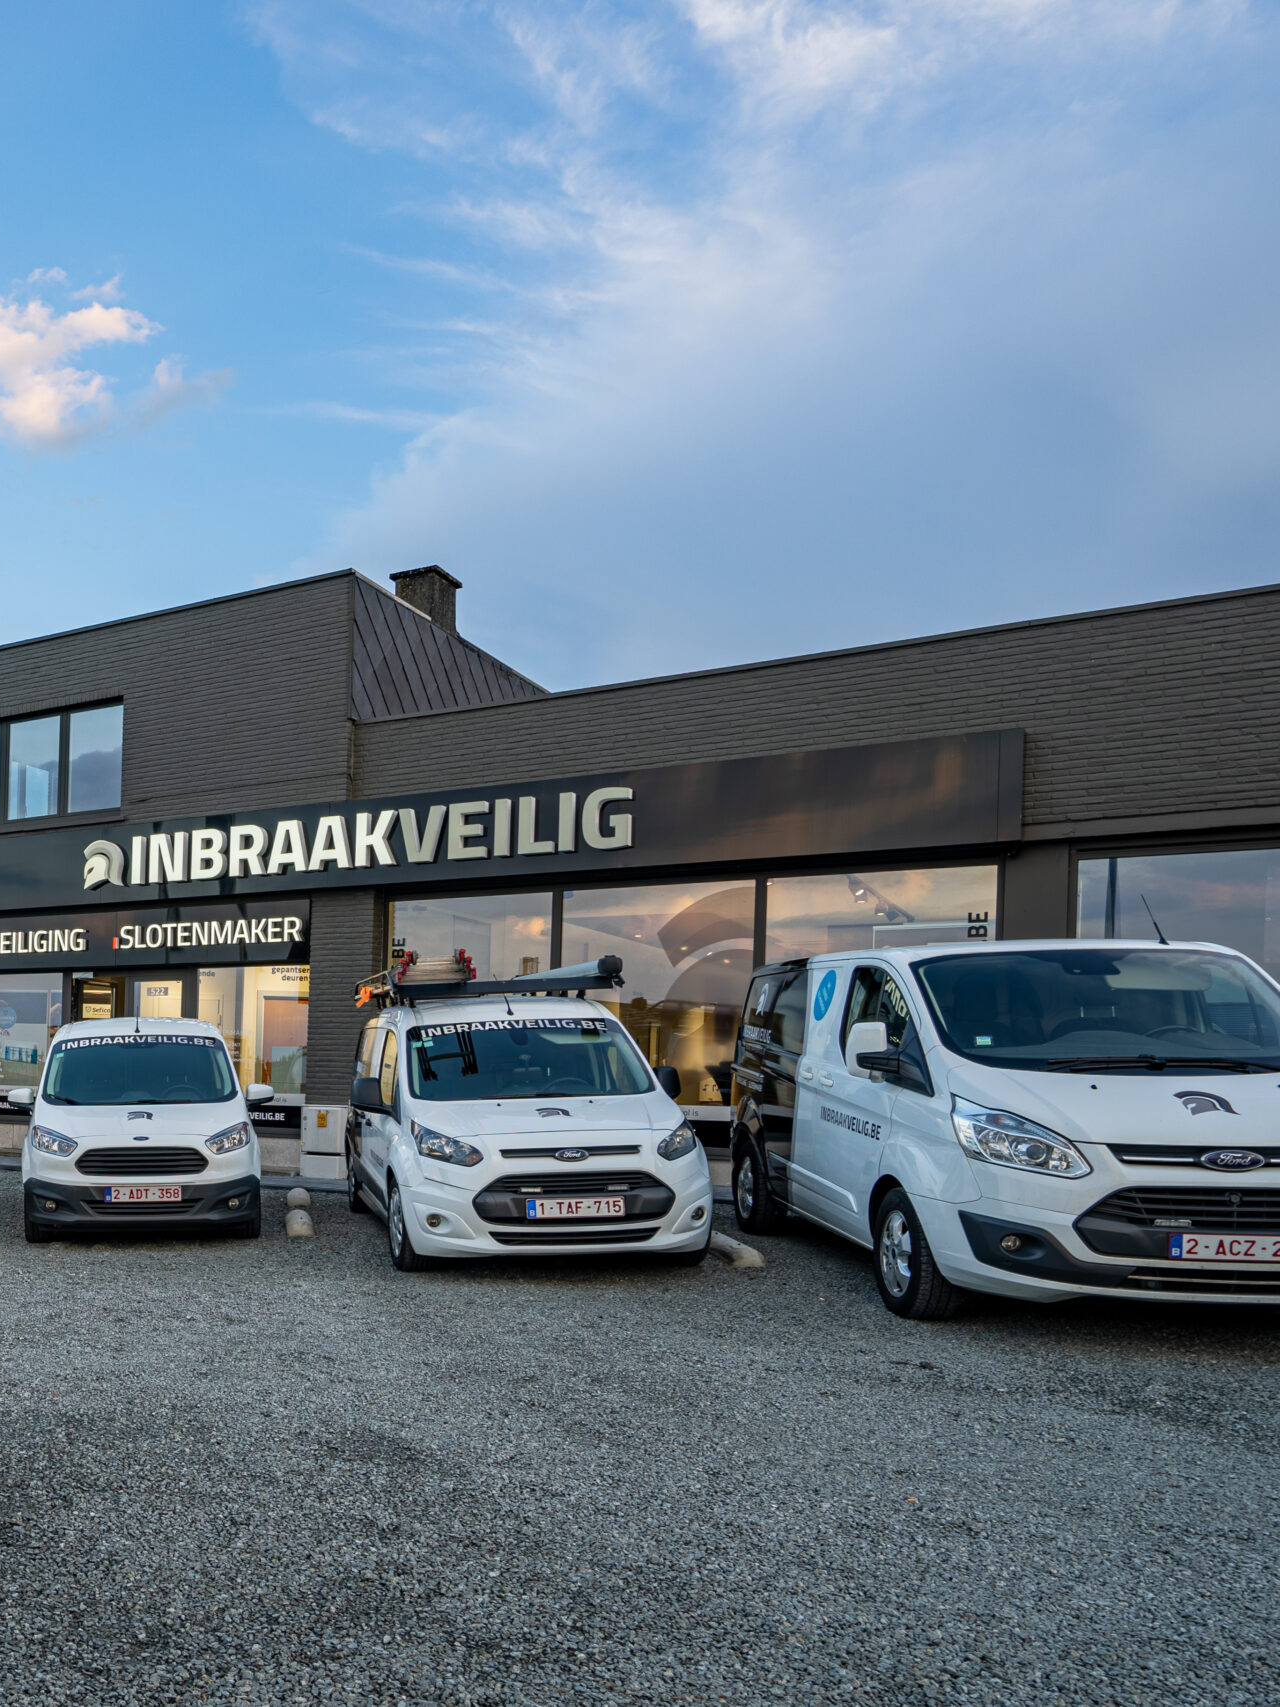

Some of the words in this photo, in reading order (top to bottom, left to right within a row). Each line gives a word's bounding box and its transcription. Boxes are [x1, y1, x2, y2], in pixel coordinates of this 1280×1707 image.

[131, 787, 634, 885] INBRAAKVEILIG
[120, 916, 303, 950] SLOTENMAKER
[967, 911, 988, 938] BE
[392, 938, 406, 959] BE
[272, 966, 309, 975] gepantser
[150, 987, 165, 996] 522
[421, 1018, 608, 1038] INBRAAKVEILIG.BE
[61, 1035, 215, 1051] INBRAAKVEILIG.BE
[821, 1106, 882, 1140] INBRAAKVEILIG.BE
[1217, 1153, 1252, 1166] Ford
[113, 1188, 180, 1200] 2-ADT-358
[539, 1200, 621, 1215] 1-TAF-715
[1186, 1238, 1280, 1257] 2-ACZ-2
